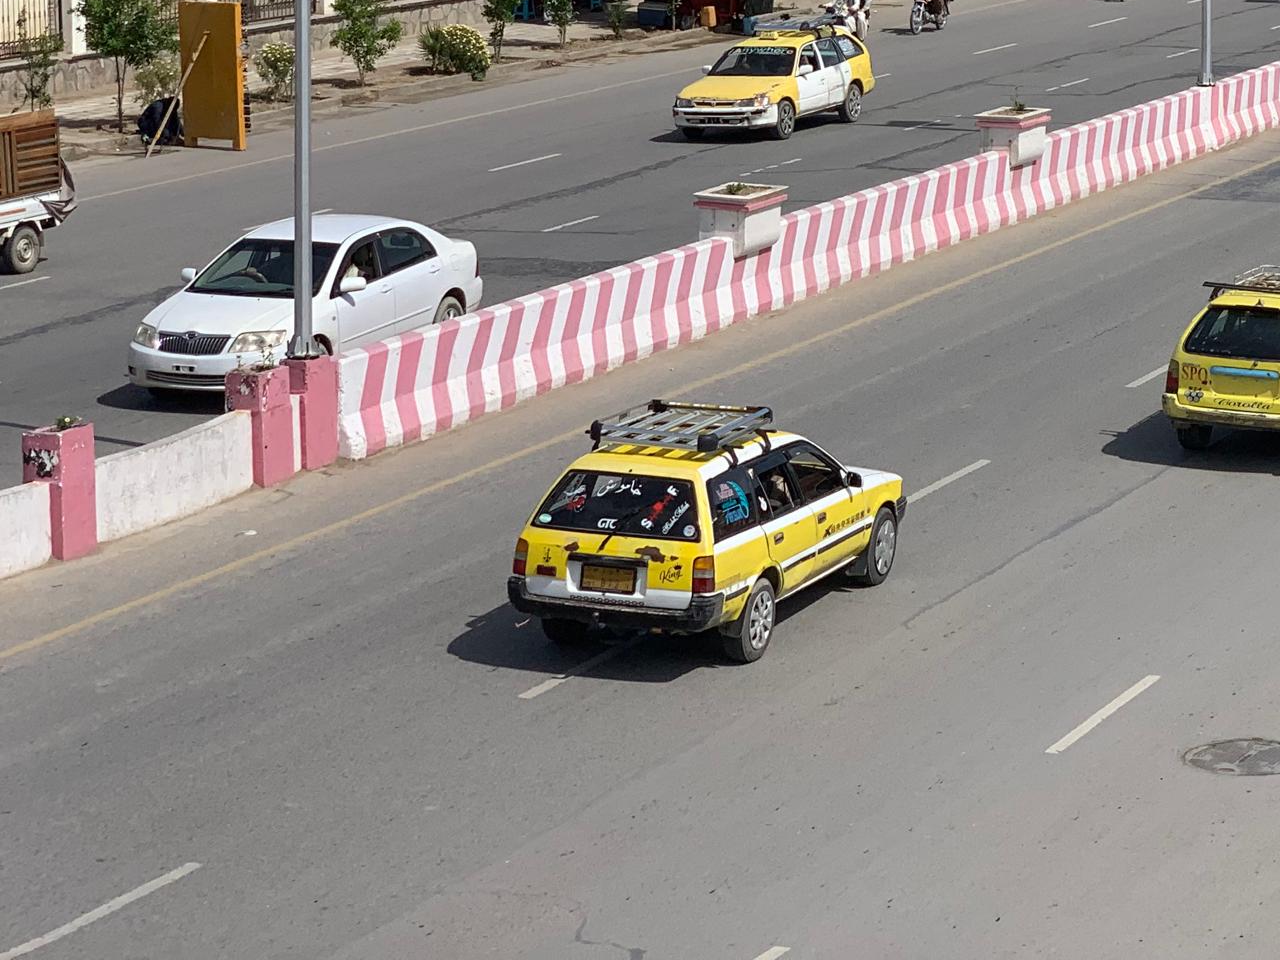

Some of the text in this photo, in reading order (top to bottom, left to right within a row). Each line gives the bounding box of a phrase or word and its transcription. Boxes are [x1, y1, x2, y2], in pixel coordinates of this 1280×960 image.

[597, 479, 642, 497] خاموش
[597, 518, 618, 529] GTC
[659, 568, 683, 583] King
